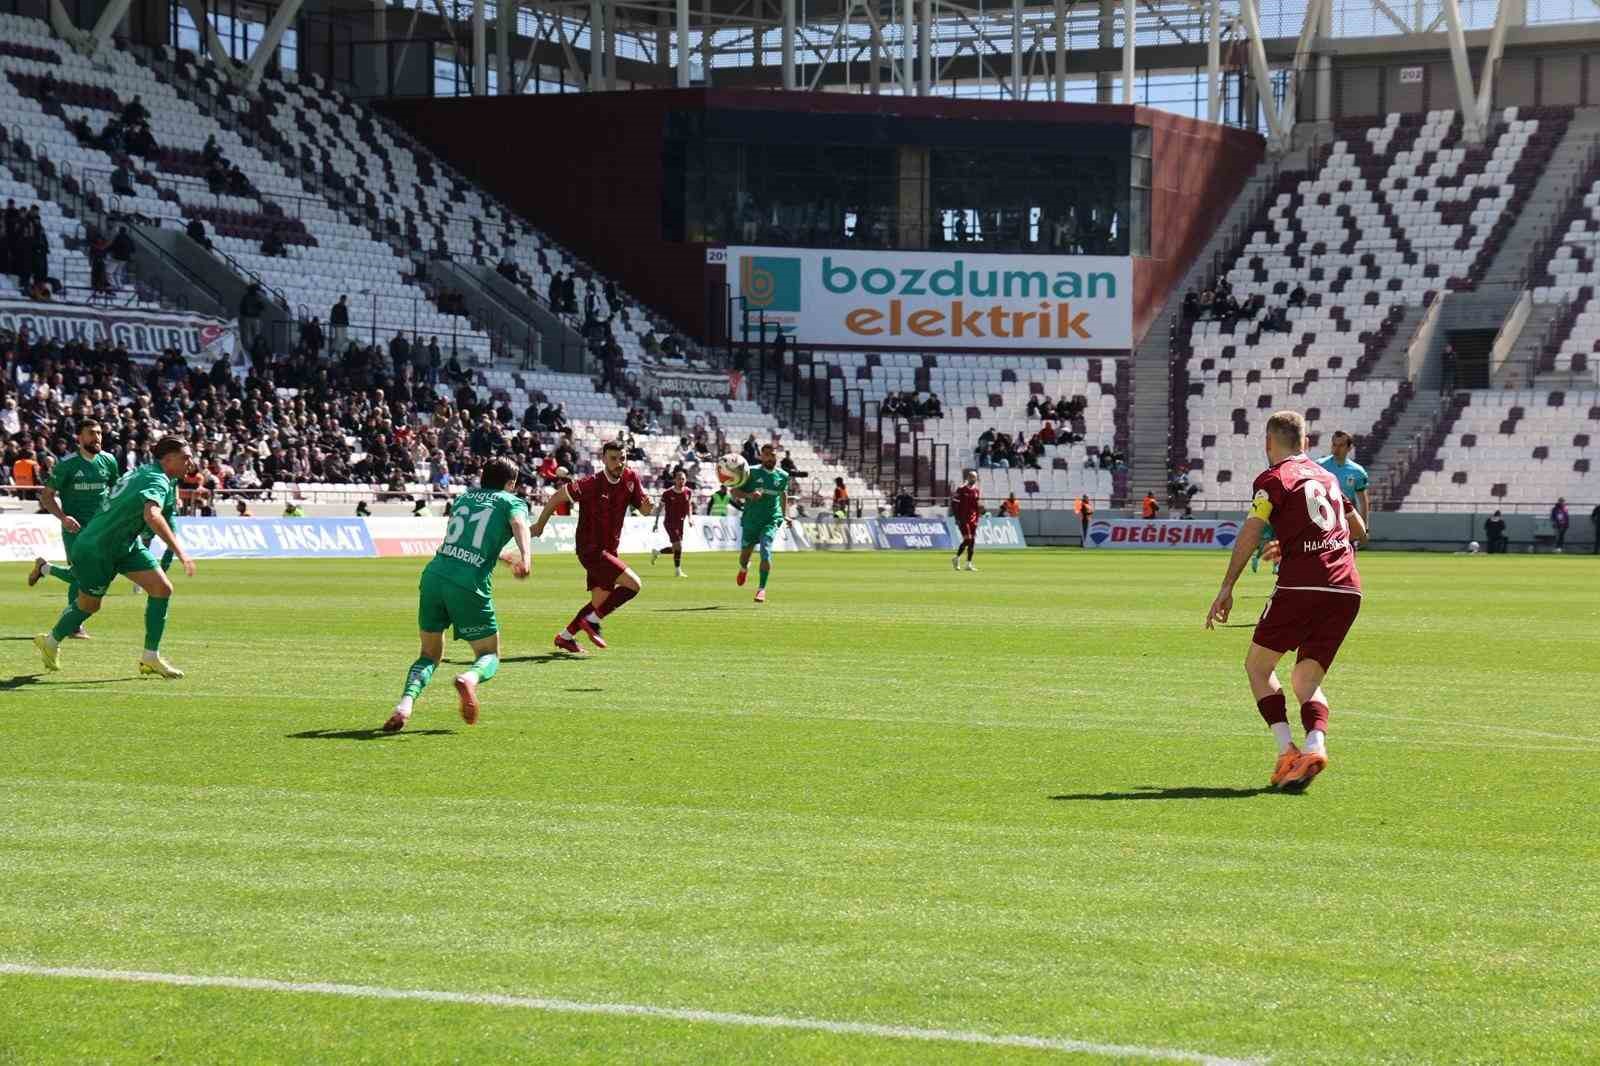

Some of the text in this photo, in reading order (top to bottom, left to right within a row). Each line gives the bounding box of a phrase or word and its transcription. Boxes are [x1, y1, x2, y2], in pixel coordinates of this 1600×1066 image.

[822, 256, 1117, 298] bozduman
[111, 322, 201, 355] GRUBU
[845, 299, 1092, 339] elektrik
[444, 505, 496, 549] 61
[1110, 523, 1215, 546] DEĞİŞİM
